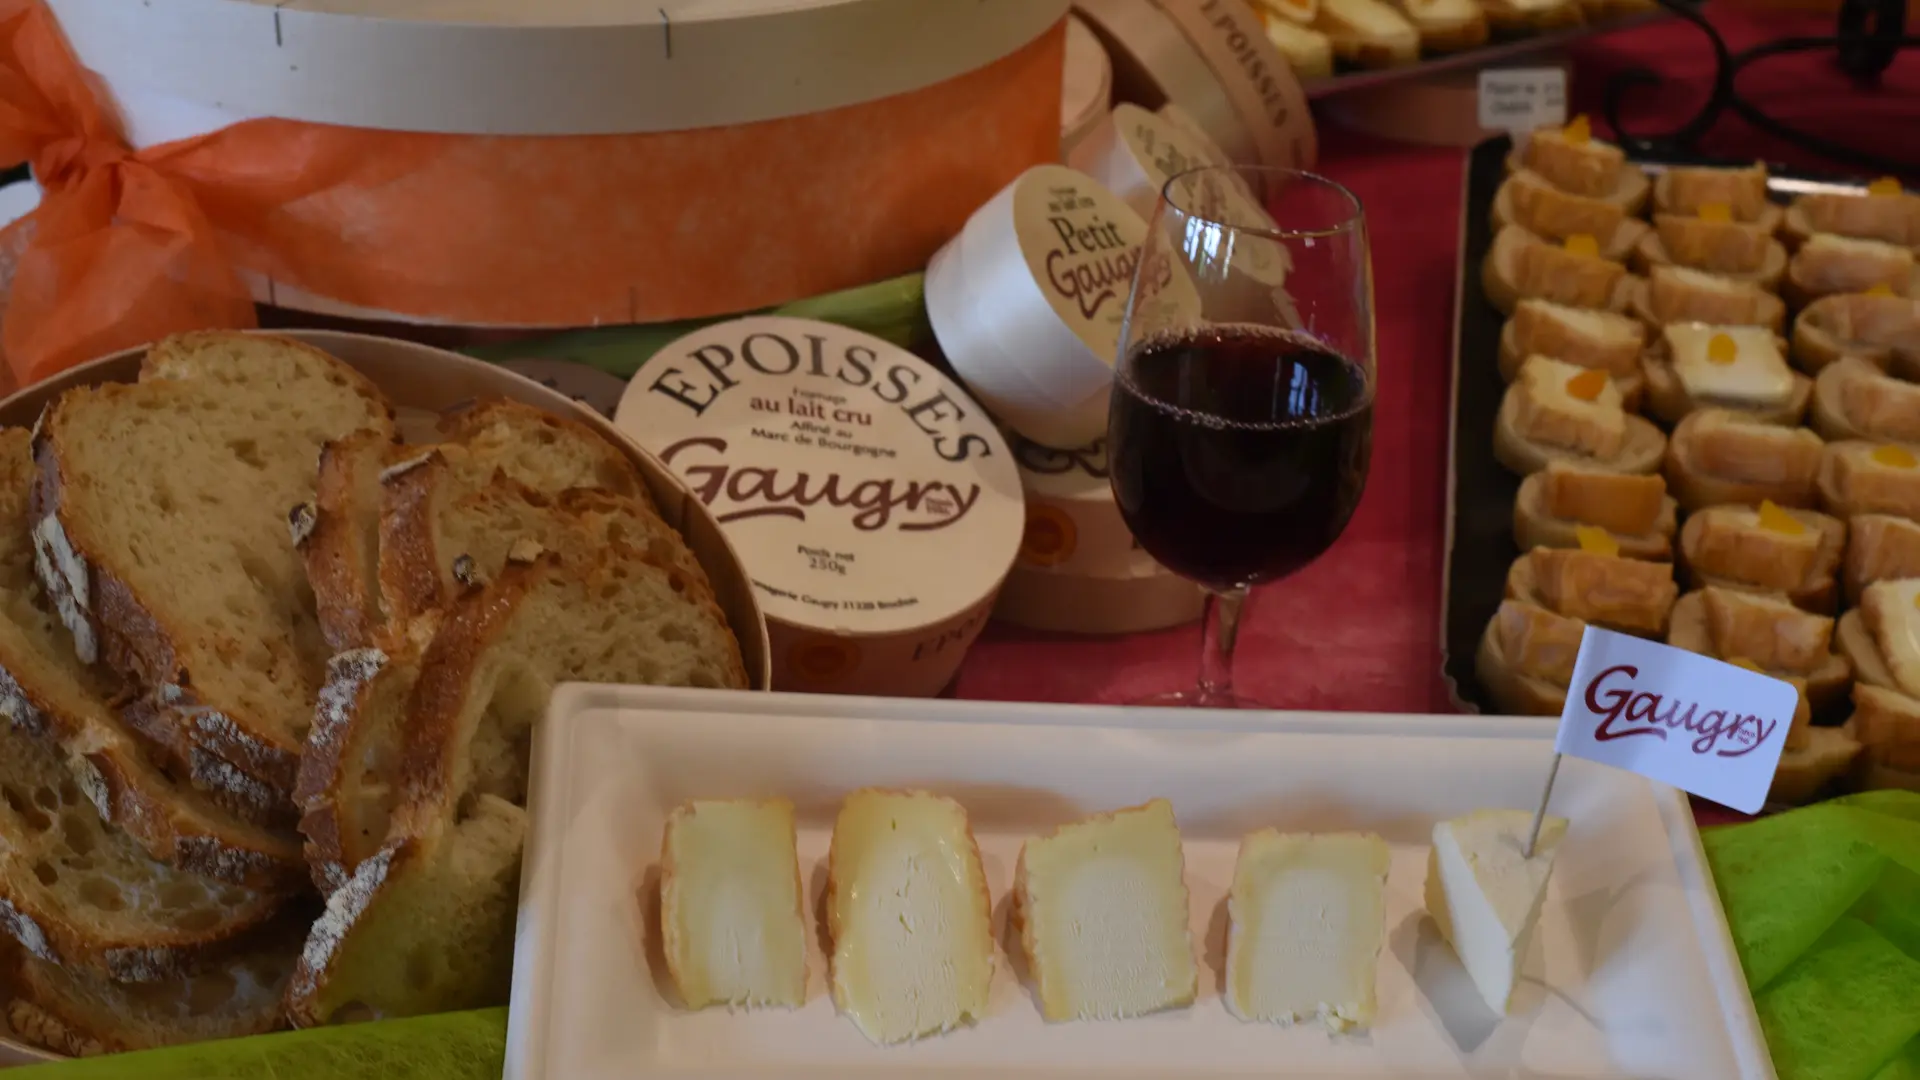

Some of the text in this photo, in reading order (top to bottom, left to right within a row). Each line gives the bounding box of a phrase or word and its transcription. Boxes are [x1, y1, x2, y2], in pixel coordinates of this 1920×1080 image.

[1048, 214, 1126, 255] Petit
[648, 332, 993, 465] EPOISSES
[750, 397, 872, 426] au lait cru
[751, 427, 897, 458] Marc de Bourgogne
[657, 437, 981, 531] Gaugry
[809, 557, 847, 575] 250g
[1585, 665, 1776, 757] Gaugry
